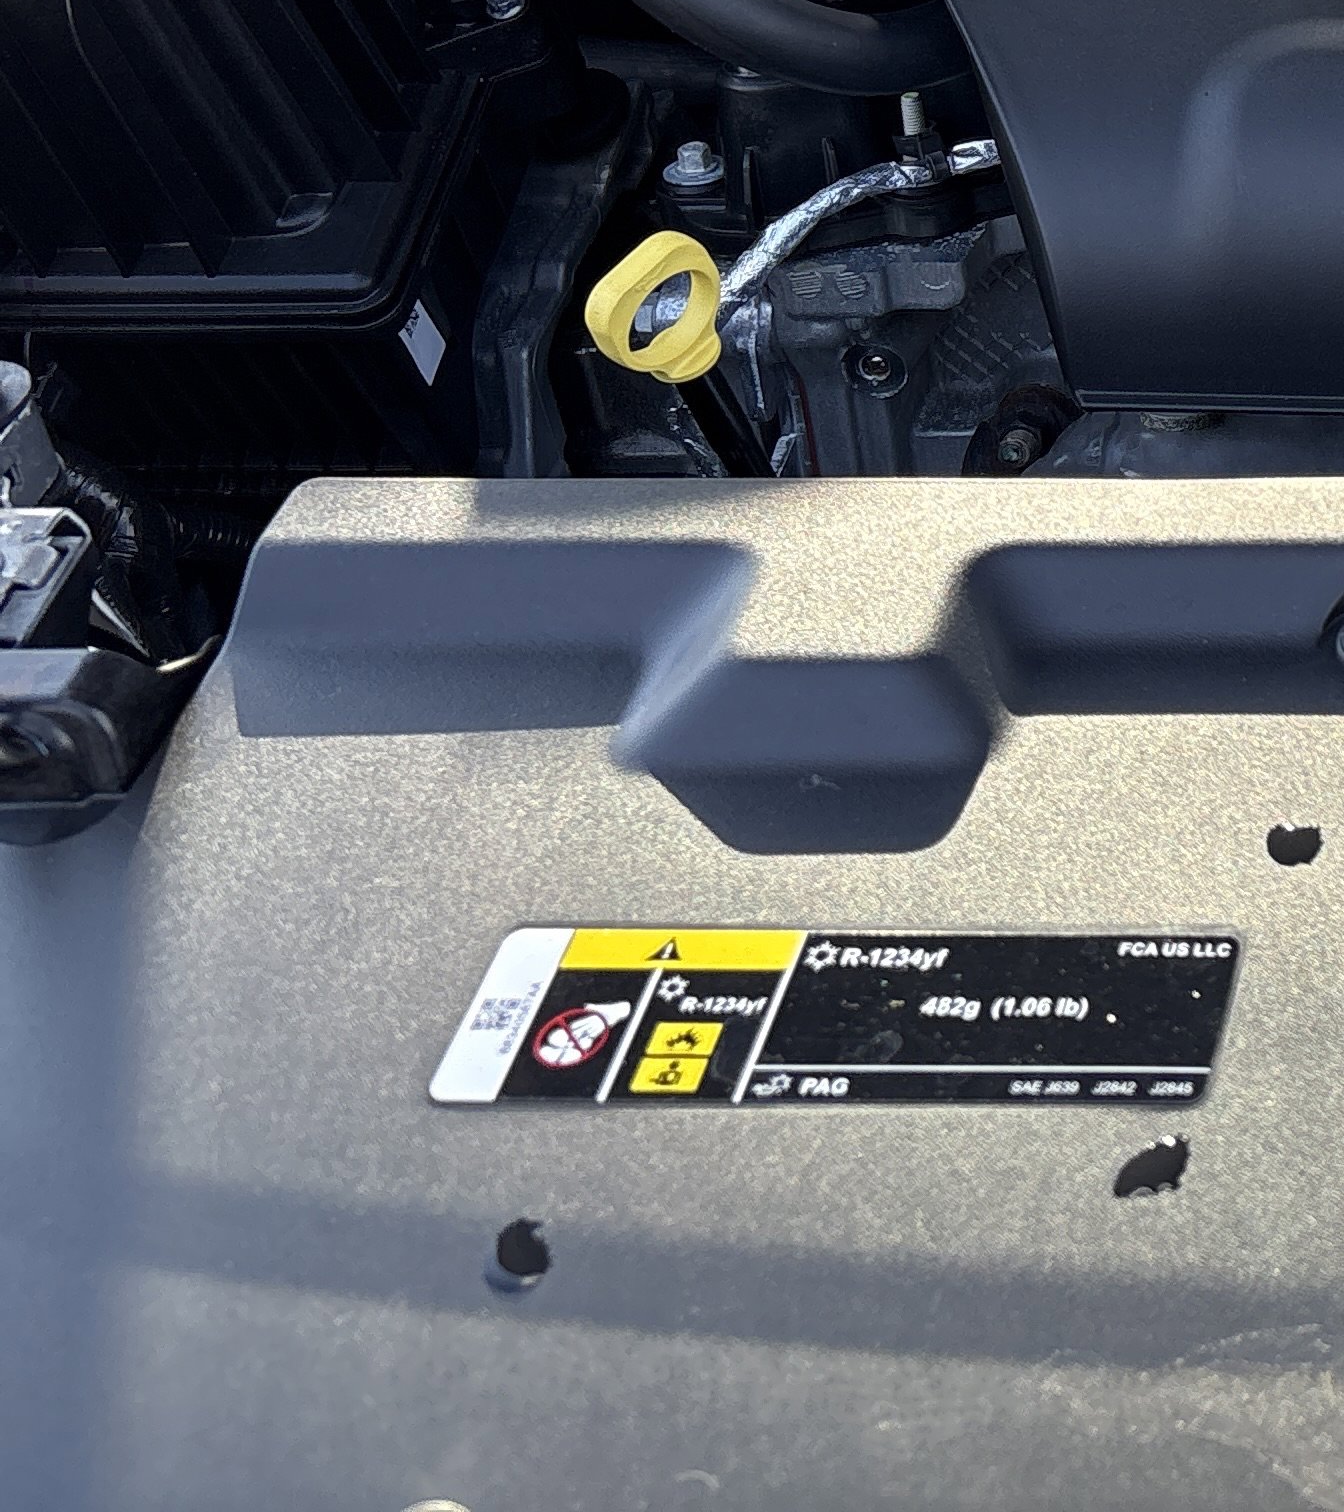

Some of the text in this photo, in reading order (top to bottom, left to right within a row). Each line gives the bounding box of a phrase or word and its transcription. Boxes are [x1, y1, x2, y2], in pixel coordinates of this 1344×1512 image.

[840, 946, 951, 972] R-1234yf
[1117, 941, 1233, 958] FCA US LLC
[677, 996, 768, 1016] R-1234yf
[918, 996, 982, 1022] 482g
[990, 996, 1052, 1022] (1.06
[798, 1076, 851, 1097] PAG
[1008, 1079, 1044, 1096] SAE
